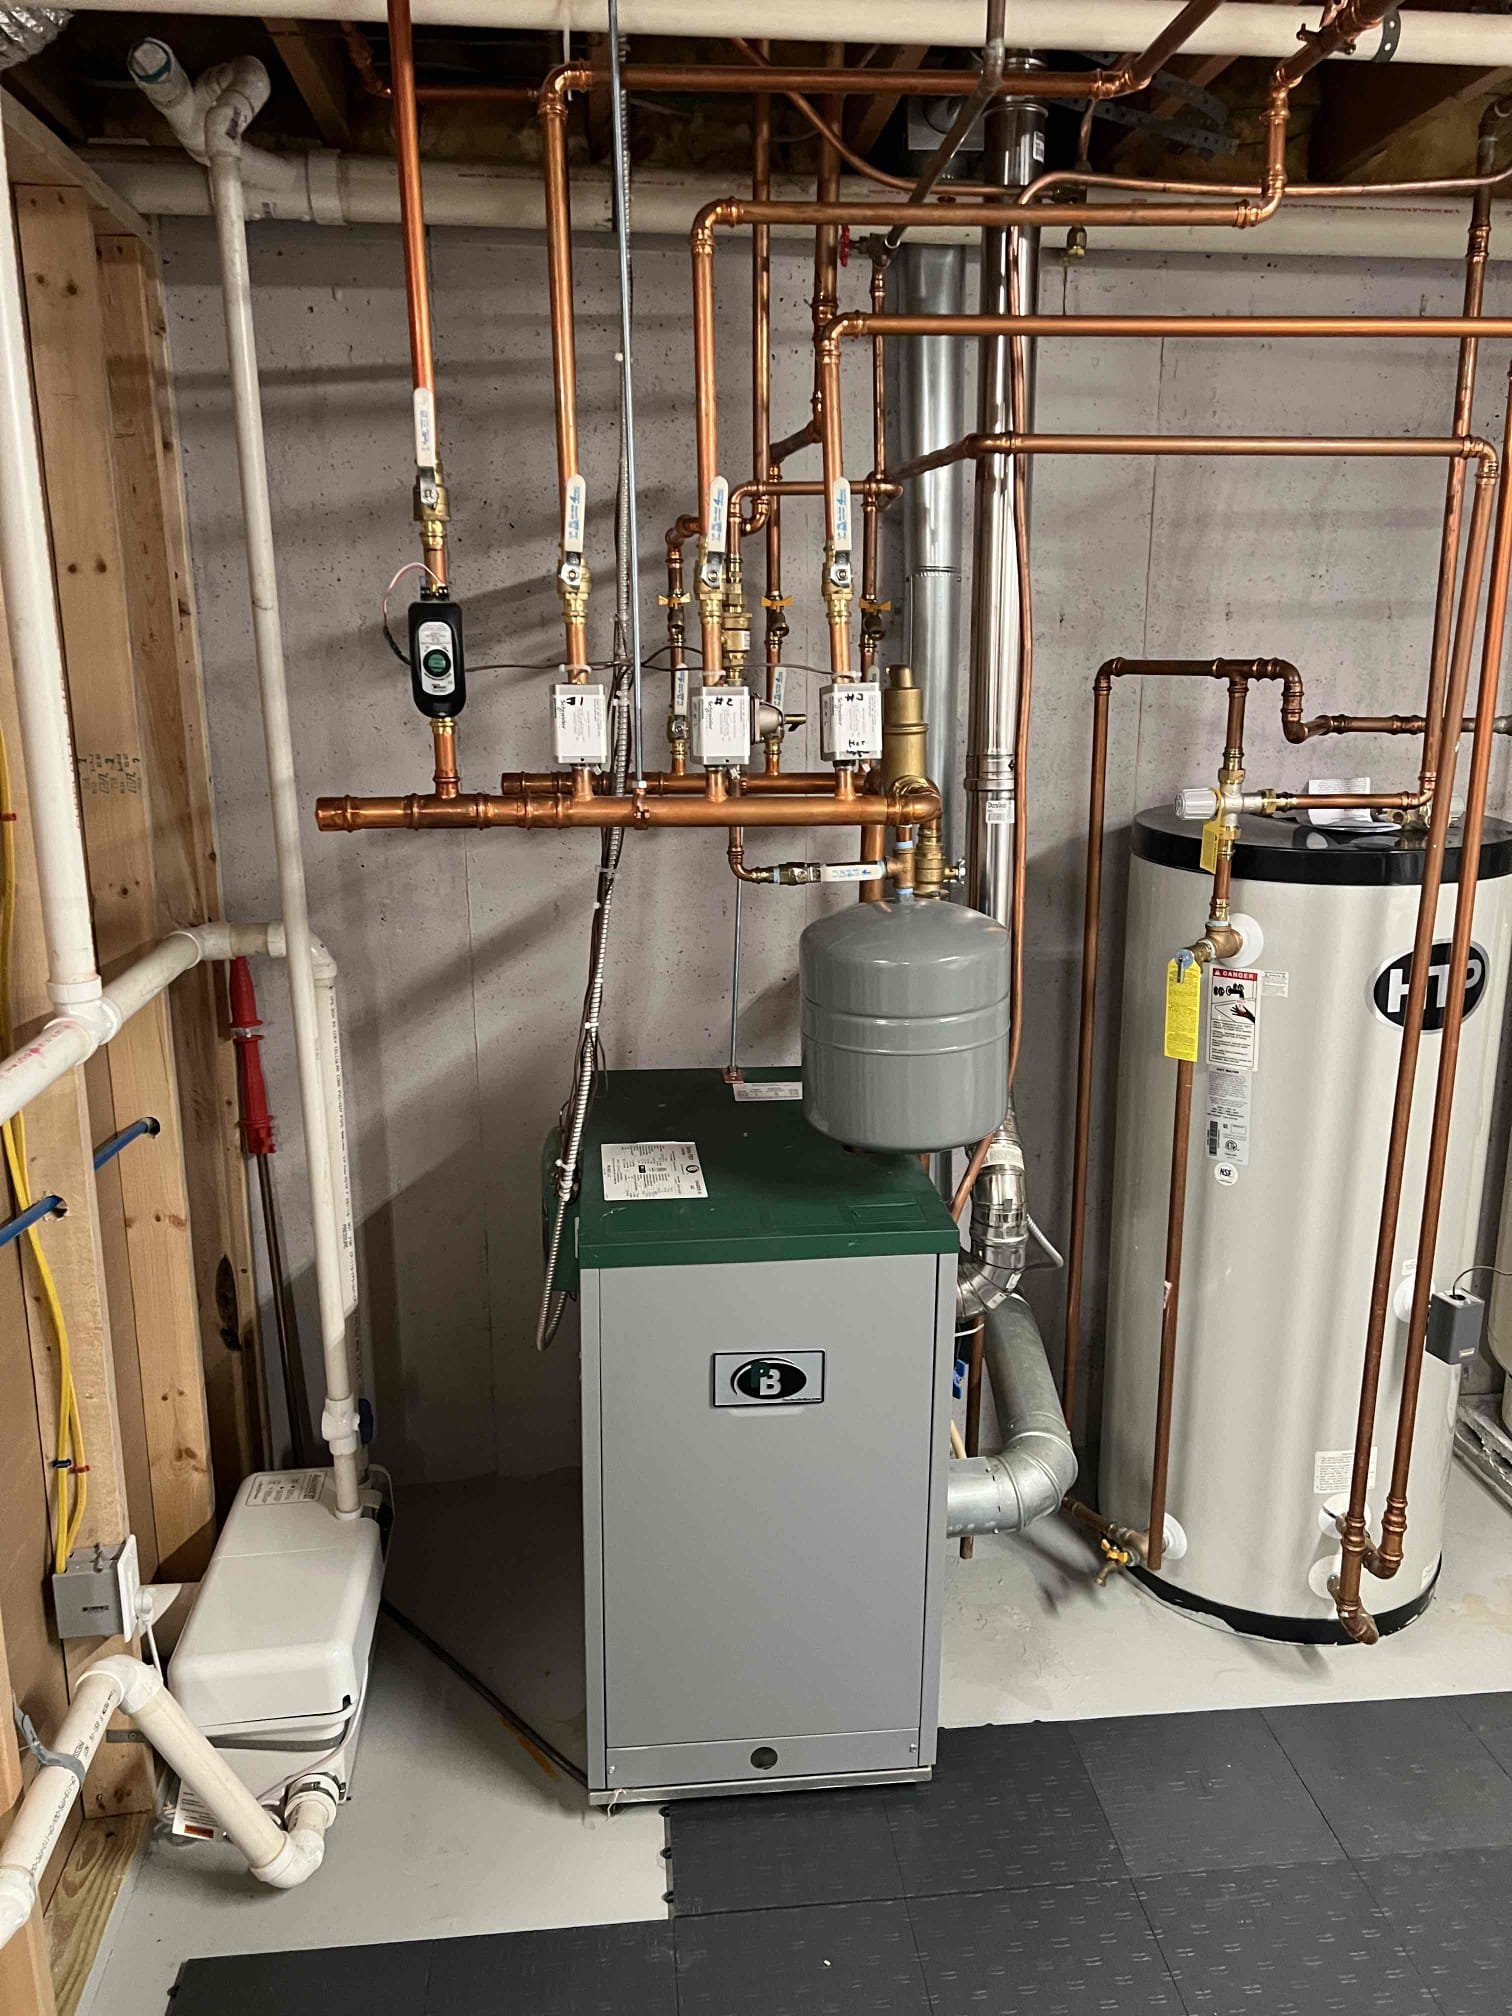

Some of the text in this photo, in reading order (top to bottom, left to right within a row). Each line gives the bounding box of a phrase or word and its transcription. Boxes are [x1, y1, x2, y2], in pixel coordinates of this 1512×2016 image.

[714, 696, 733, 706] #2
[1222, 969, 1254, 979] DANGER
[1387, 958, 1482, 1013] HTP
[1219, 1168, 1232, 1177] NSF
